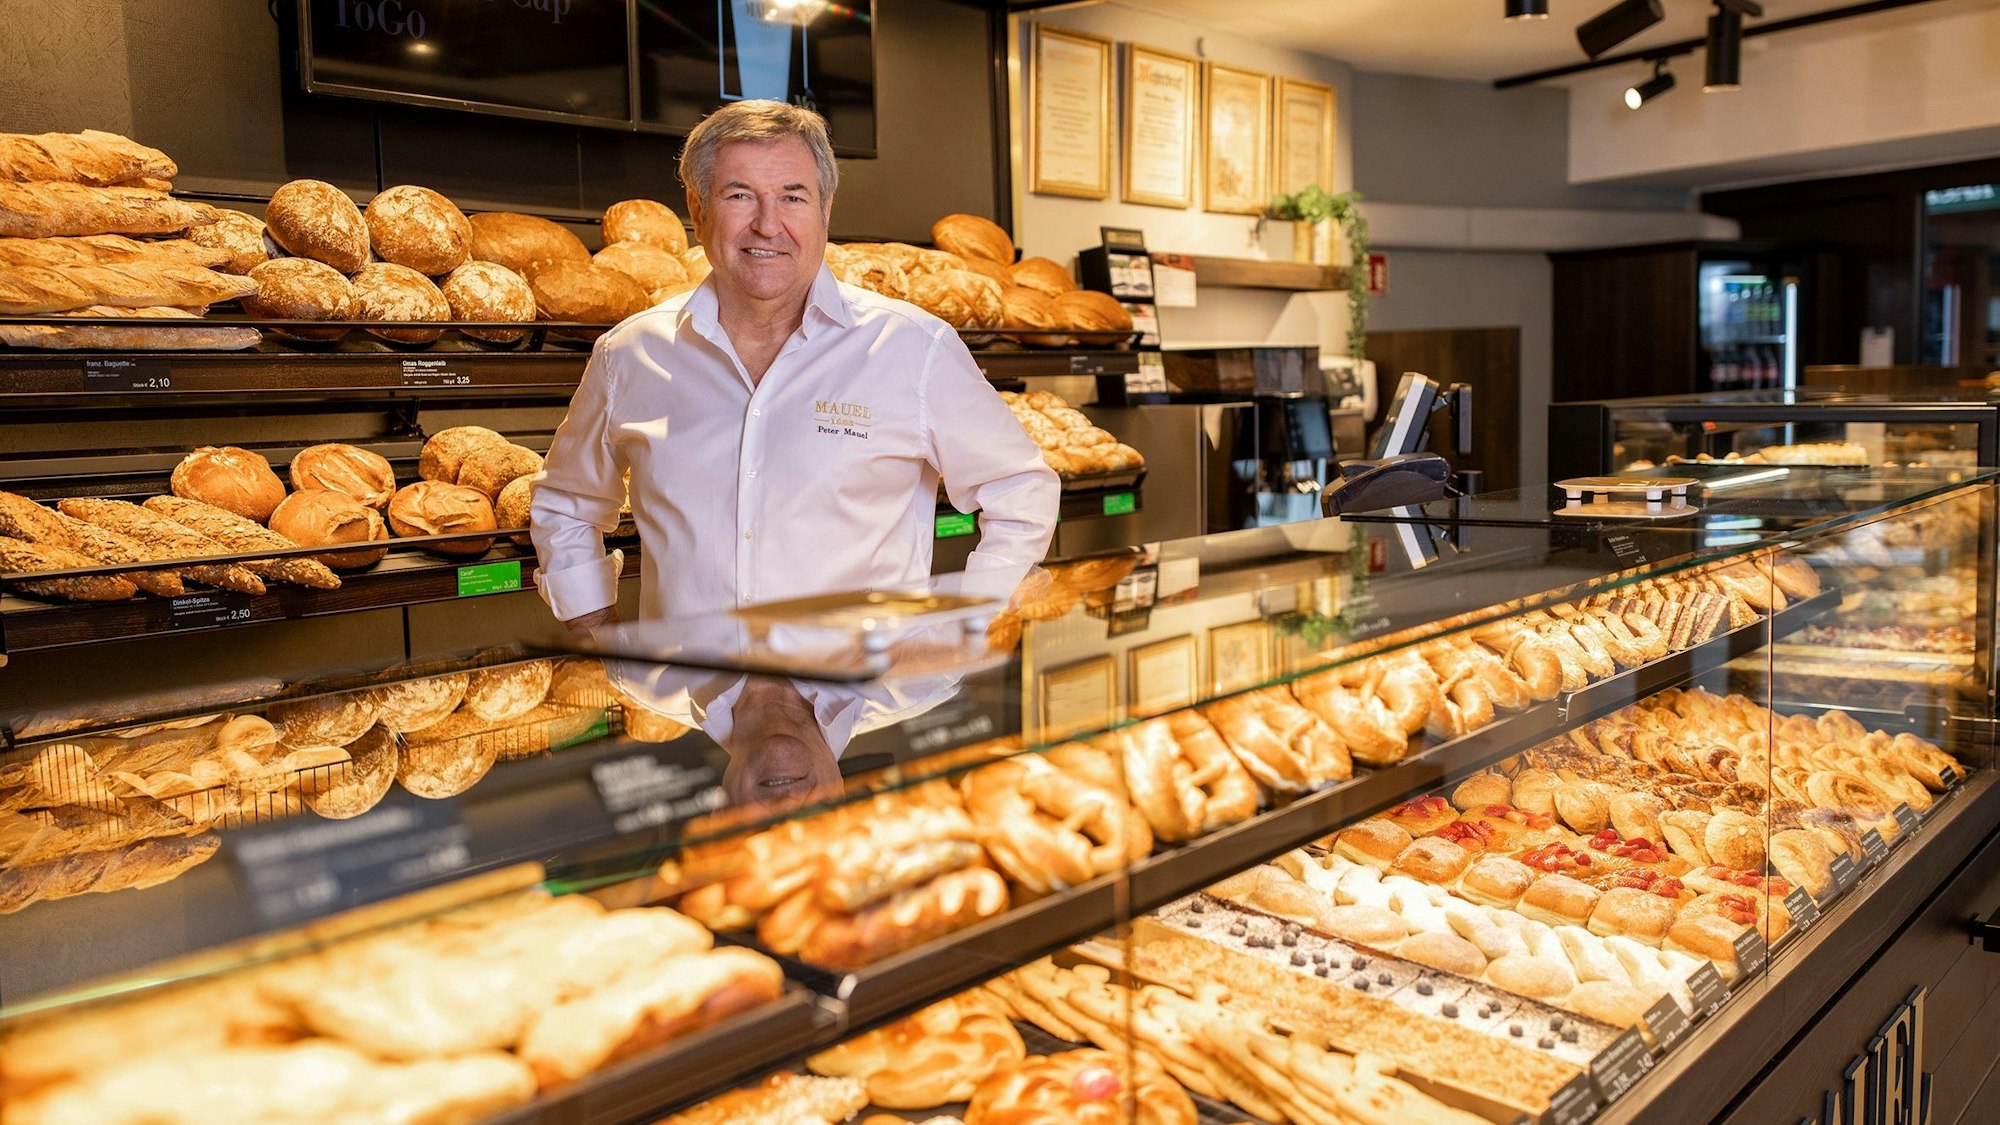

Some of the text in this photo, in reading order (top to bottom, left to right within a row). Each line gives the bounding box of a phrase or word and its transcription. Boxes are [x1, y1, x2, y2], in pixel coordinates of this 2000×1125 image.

[149, 378, 170, 388] 2,10
[815, 400, 871, 419] MAUEL
[817, 425, 868, 440] Peter Mauel
[503, 579, 518, 589] 3,20
[172, 598, 210, 606] Dinkel-Spitze
[231, 608, 250, 620] 2,50
[1801, 984, 1934, 1125] UEL
